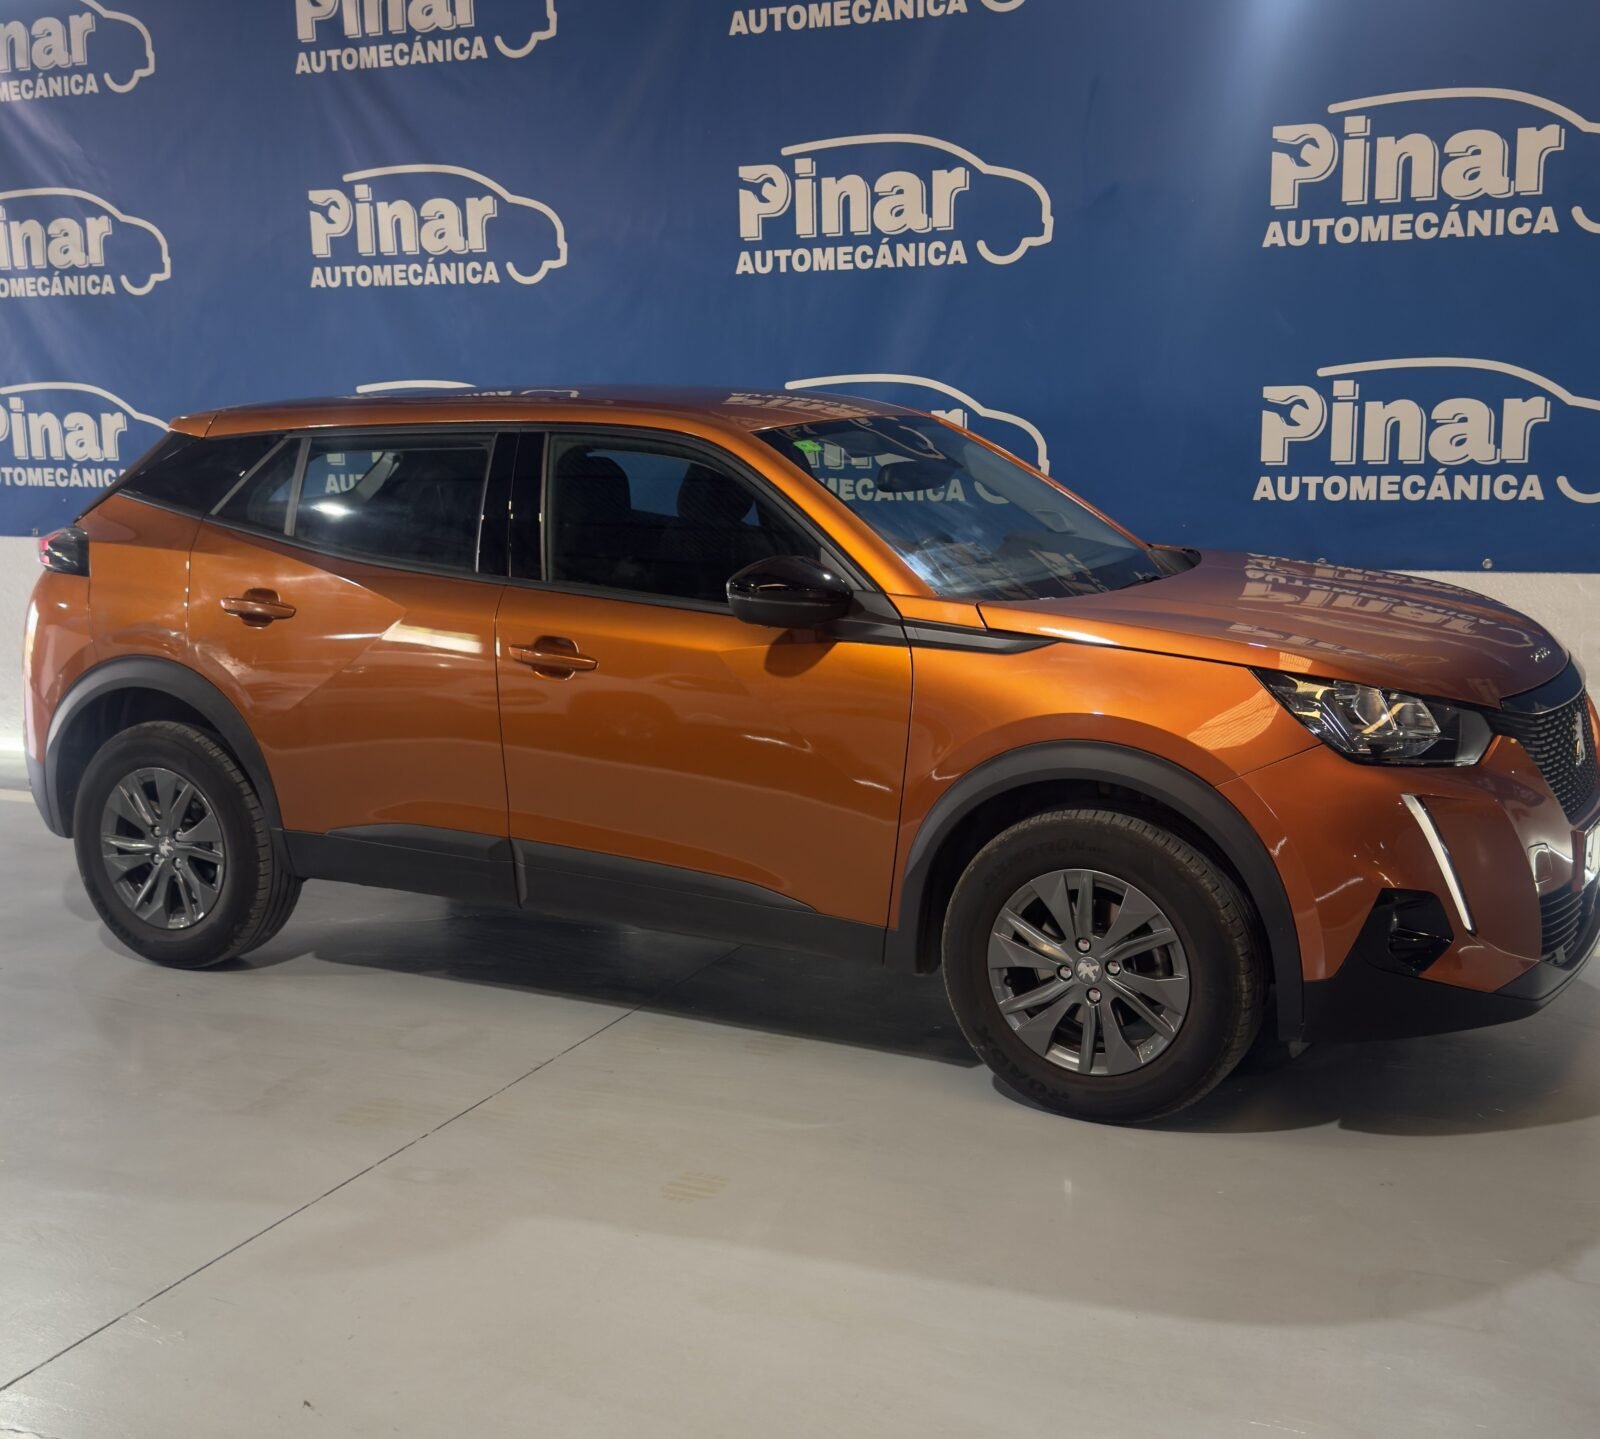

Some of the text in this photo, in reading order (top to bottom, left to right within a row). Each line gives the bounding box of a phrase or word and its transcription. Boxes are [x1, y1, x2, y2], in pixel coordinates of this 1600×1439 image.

[296, 36, 488, 74] AUTOMECÁNICA
[1270, 115, 1565, 209] Pinar
[738, 158, 969, 241] Pinar
[308, 184, 497, 258] Pinar
[1262, 204, 1559, 247] AUTOMECÁNICA
[310, 259, 500, 288] AUTOMECÁNICA
[735, 238, 968, 275] AUTOMECÁNICA
[1261, 380, 1550, 465] Pinar
[0, 463, 126, 488] TOMECÁNIC
[1252, 468, 1545, 501] AUTOMECÁNICA
